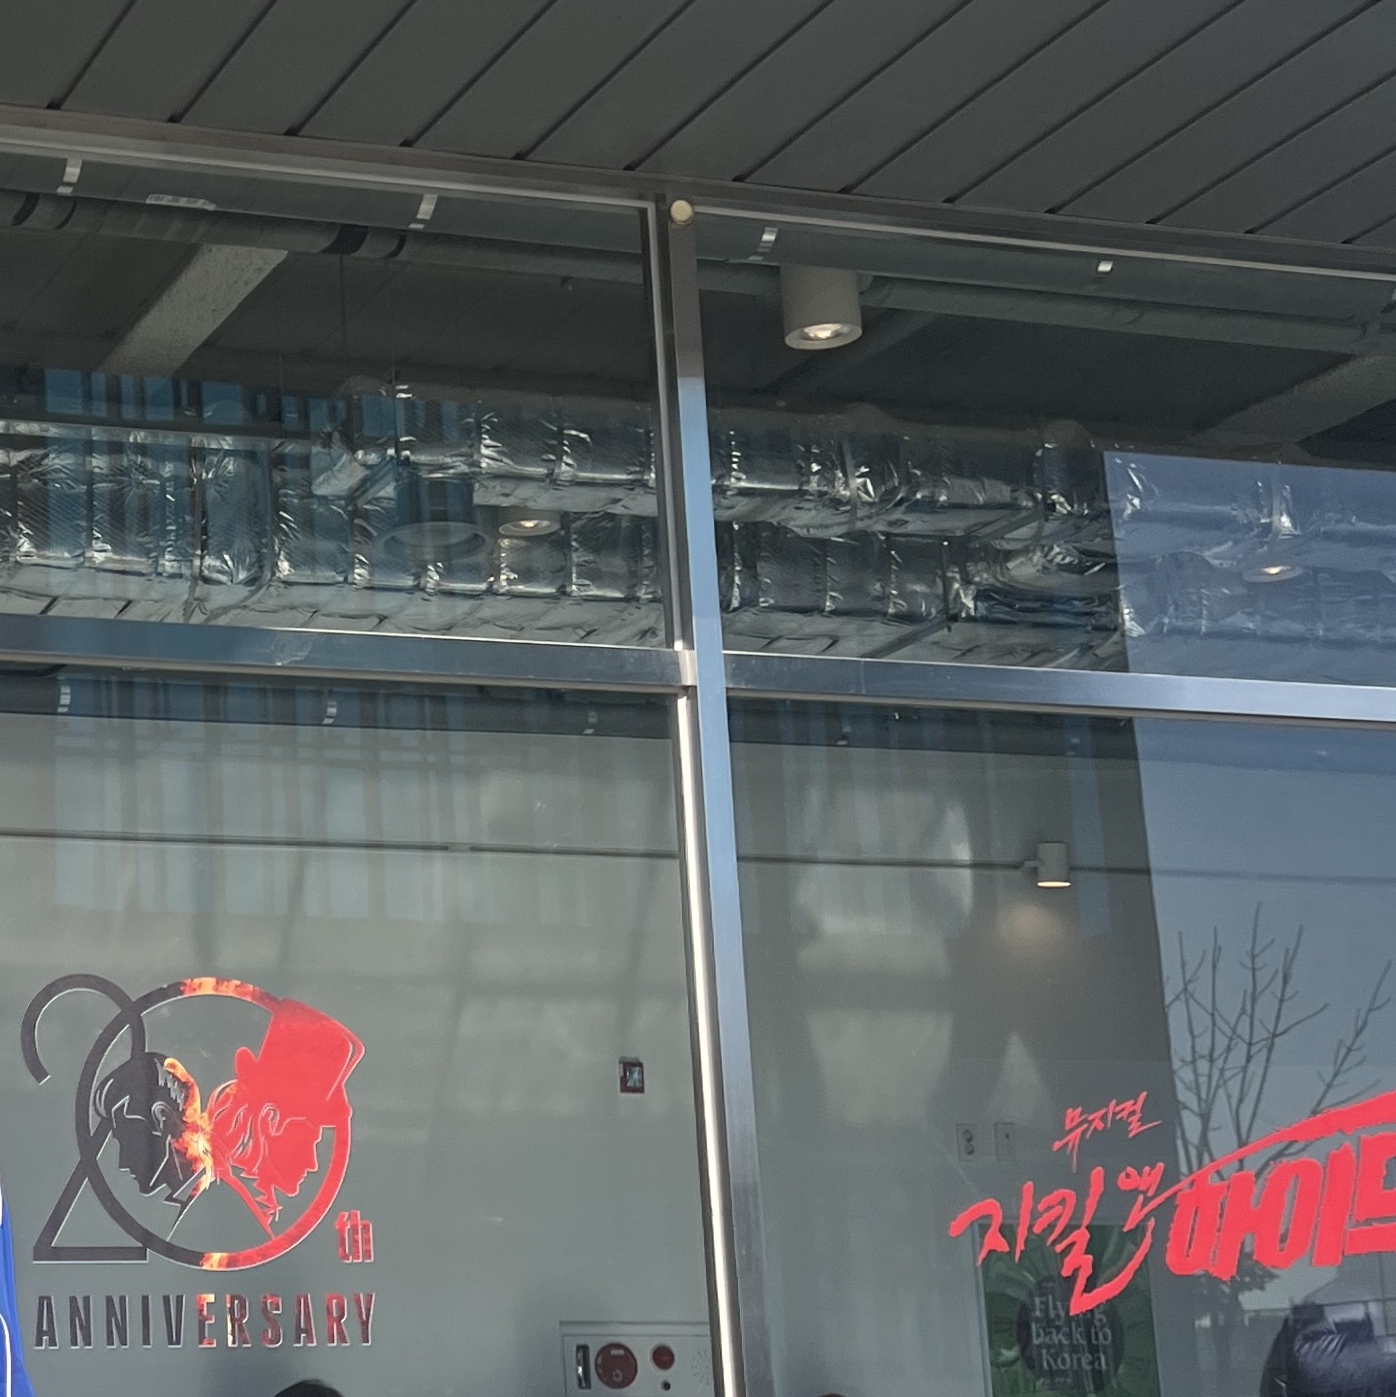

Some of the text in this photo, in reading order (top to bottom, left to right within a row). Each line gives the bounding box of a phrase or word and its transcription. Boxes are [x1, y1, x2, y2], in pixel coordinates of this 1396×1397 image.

[1052, 1091, 1162, 1173] 뮤지컬
[33, 1292, 377, 1350] ANNIVERSARY
[1032, 1293, 1107, 1326] Flyg
[1031, 1321, 1113, 1346] back to
[1041, 1347, 1108, 1372] Korea
